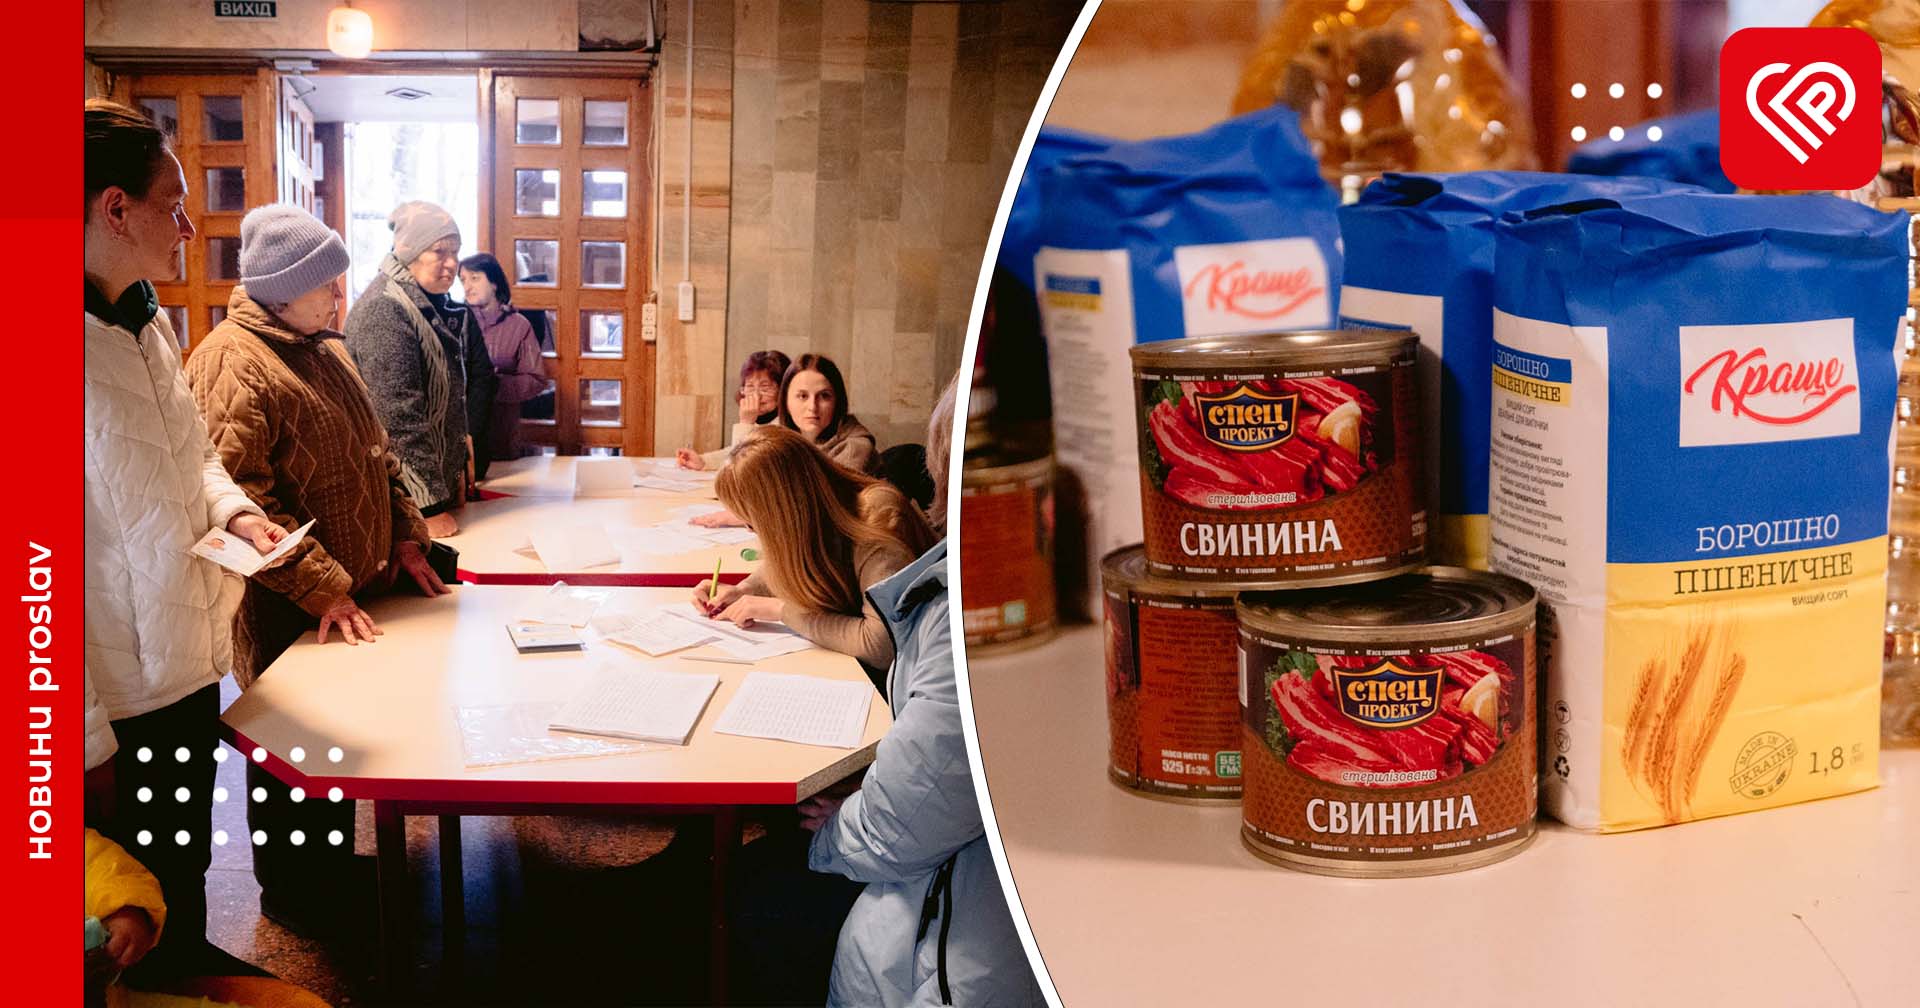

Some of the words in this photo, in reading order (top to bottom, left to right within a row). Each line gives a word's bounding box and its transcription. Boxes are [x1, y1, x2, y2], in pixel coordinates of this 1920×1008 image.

[220, 2, 272, 16] ВИХІД
[1496, 349, 1549, 378] БОРОШНО
[1493, 368, 1561, 402] ПШЕНИЧНЕ
[1685, 347, 1857, 425] Краще
[1219, 427, 1275, 442] ПРОЕКТ
[1208, 491, 1297, 508] стерилізована
[1180, 519, 1343, 556] СВИНИНА
[1695, 514, 1840, 552] БОРОШНО
[1674, 552, 1853, 595] ПШЕНИЧНЕ
[1792, 595, 1825, 606] ВИЩИЙ
[1827, 590, 1849, 601] СОРТ
[1359, 703, 1418, 719] ПРОЕКТ
[1740, 737, 1763, 765] MADE
[1767, 735, 1779, 745] IN
[1808, 746, 1844, 776] 1,8
[1161, 759, 1184, 773] 525
[1342, 769, 1437, 785] стерилізована
[1732, 743, 1796, 789] UKRAINE
[1306, 795, 1478, 835] СВИНИНА
